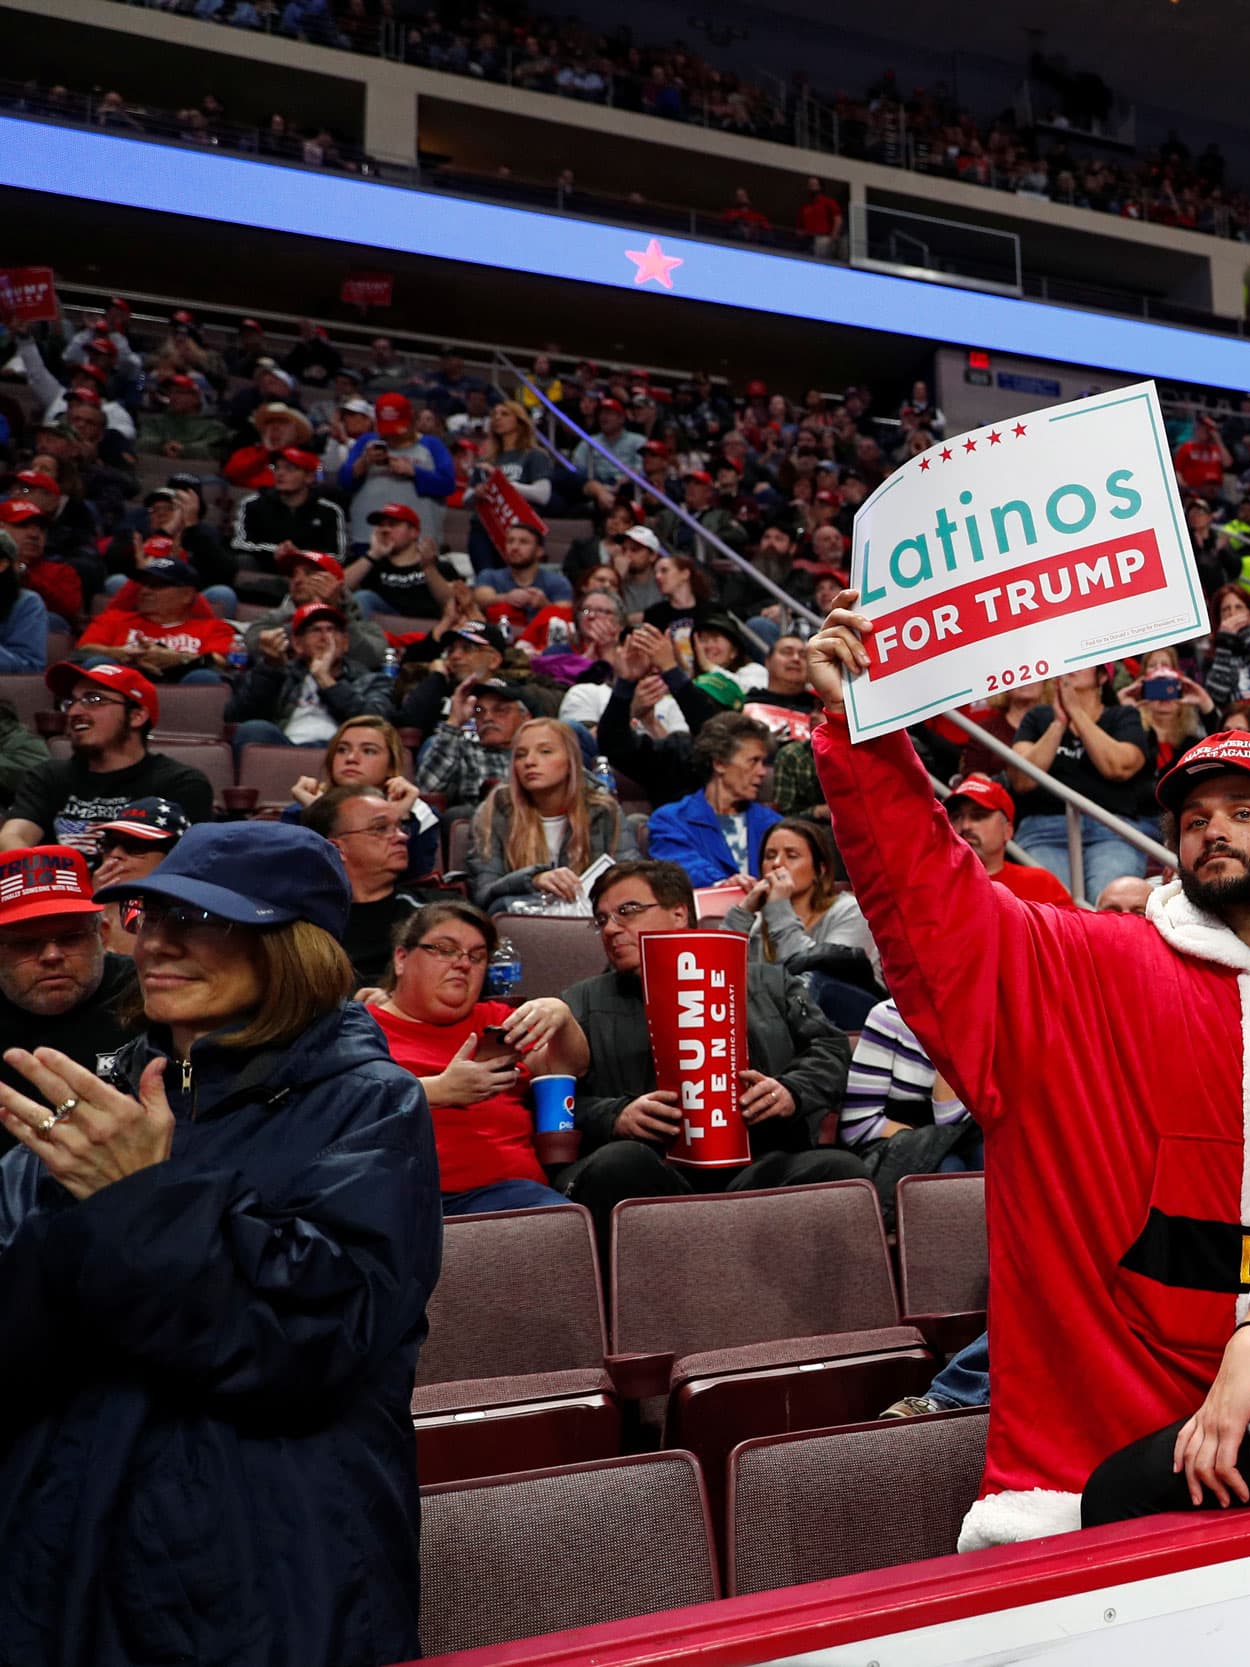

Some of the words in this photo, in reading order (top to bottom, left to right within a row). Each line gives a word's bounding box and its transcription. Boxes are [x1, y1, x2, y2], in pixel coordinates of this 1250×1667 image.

[860, 469, 1142, 606] Latinos
[874, 604, 963, 664] FOR
[975, 549, 1146, 623] TRUMP
[987, 660, 1050, 691] 2020
[64, 803, 128, 819] AMERIC
[0, 855, 75, 879] TRUMP
[26, 871, 55, 886] 16
[677, 951, 706, 1146] TRUMP
[710, 969, 728, 1128] PENCE
